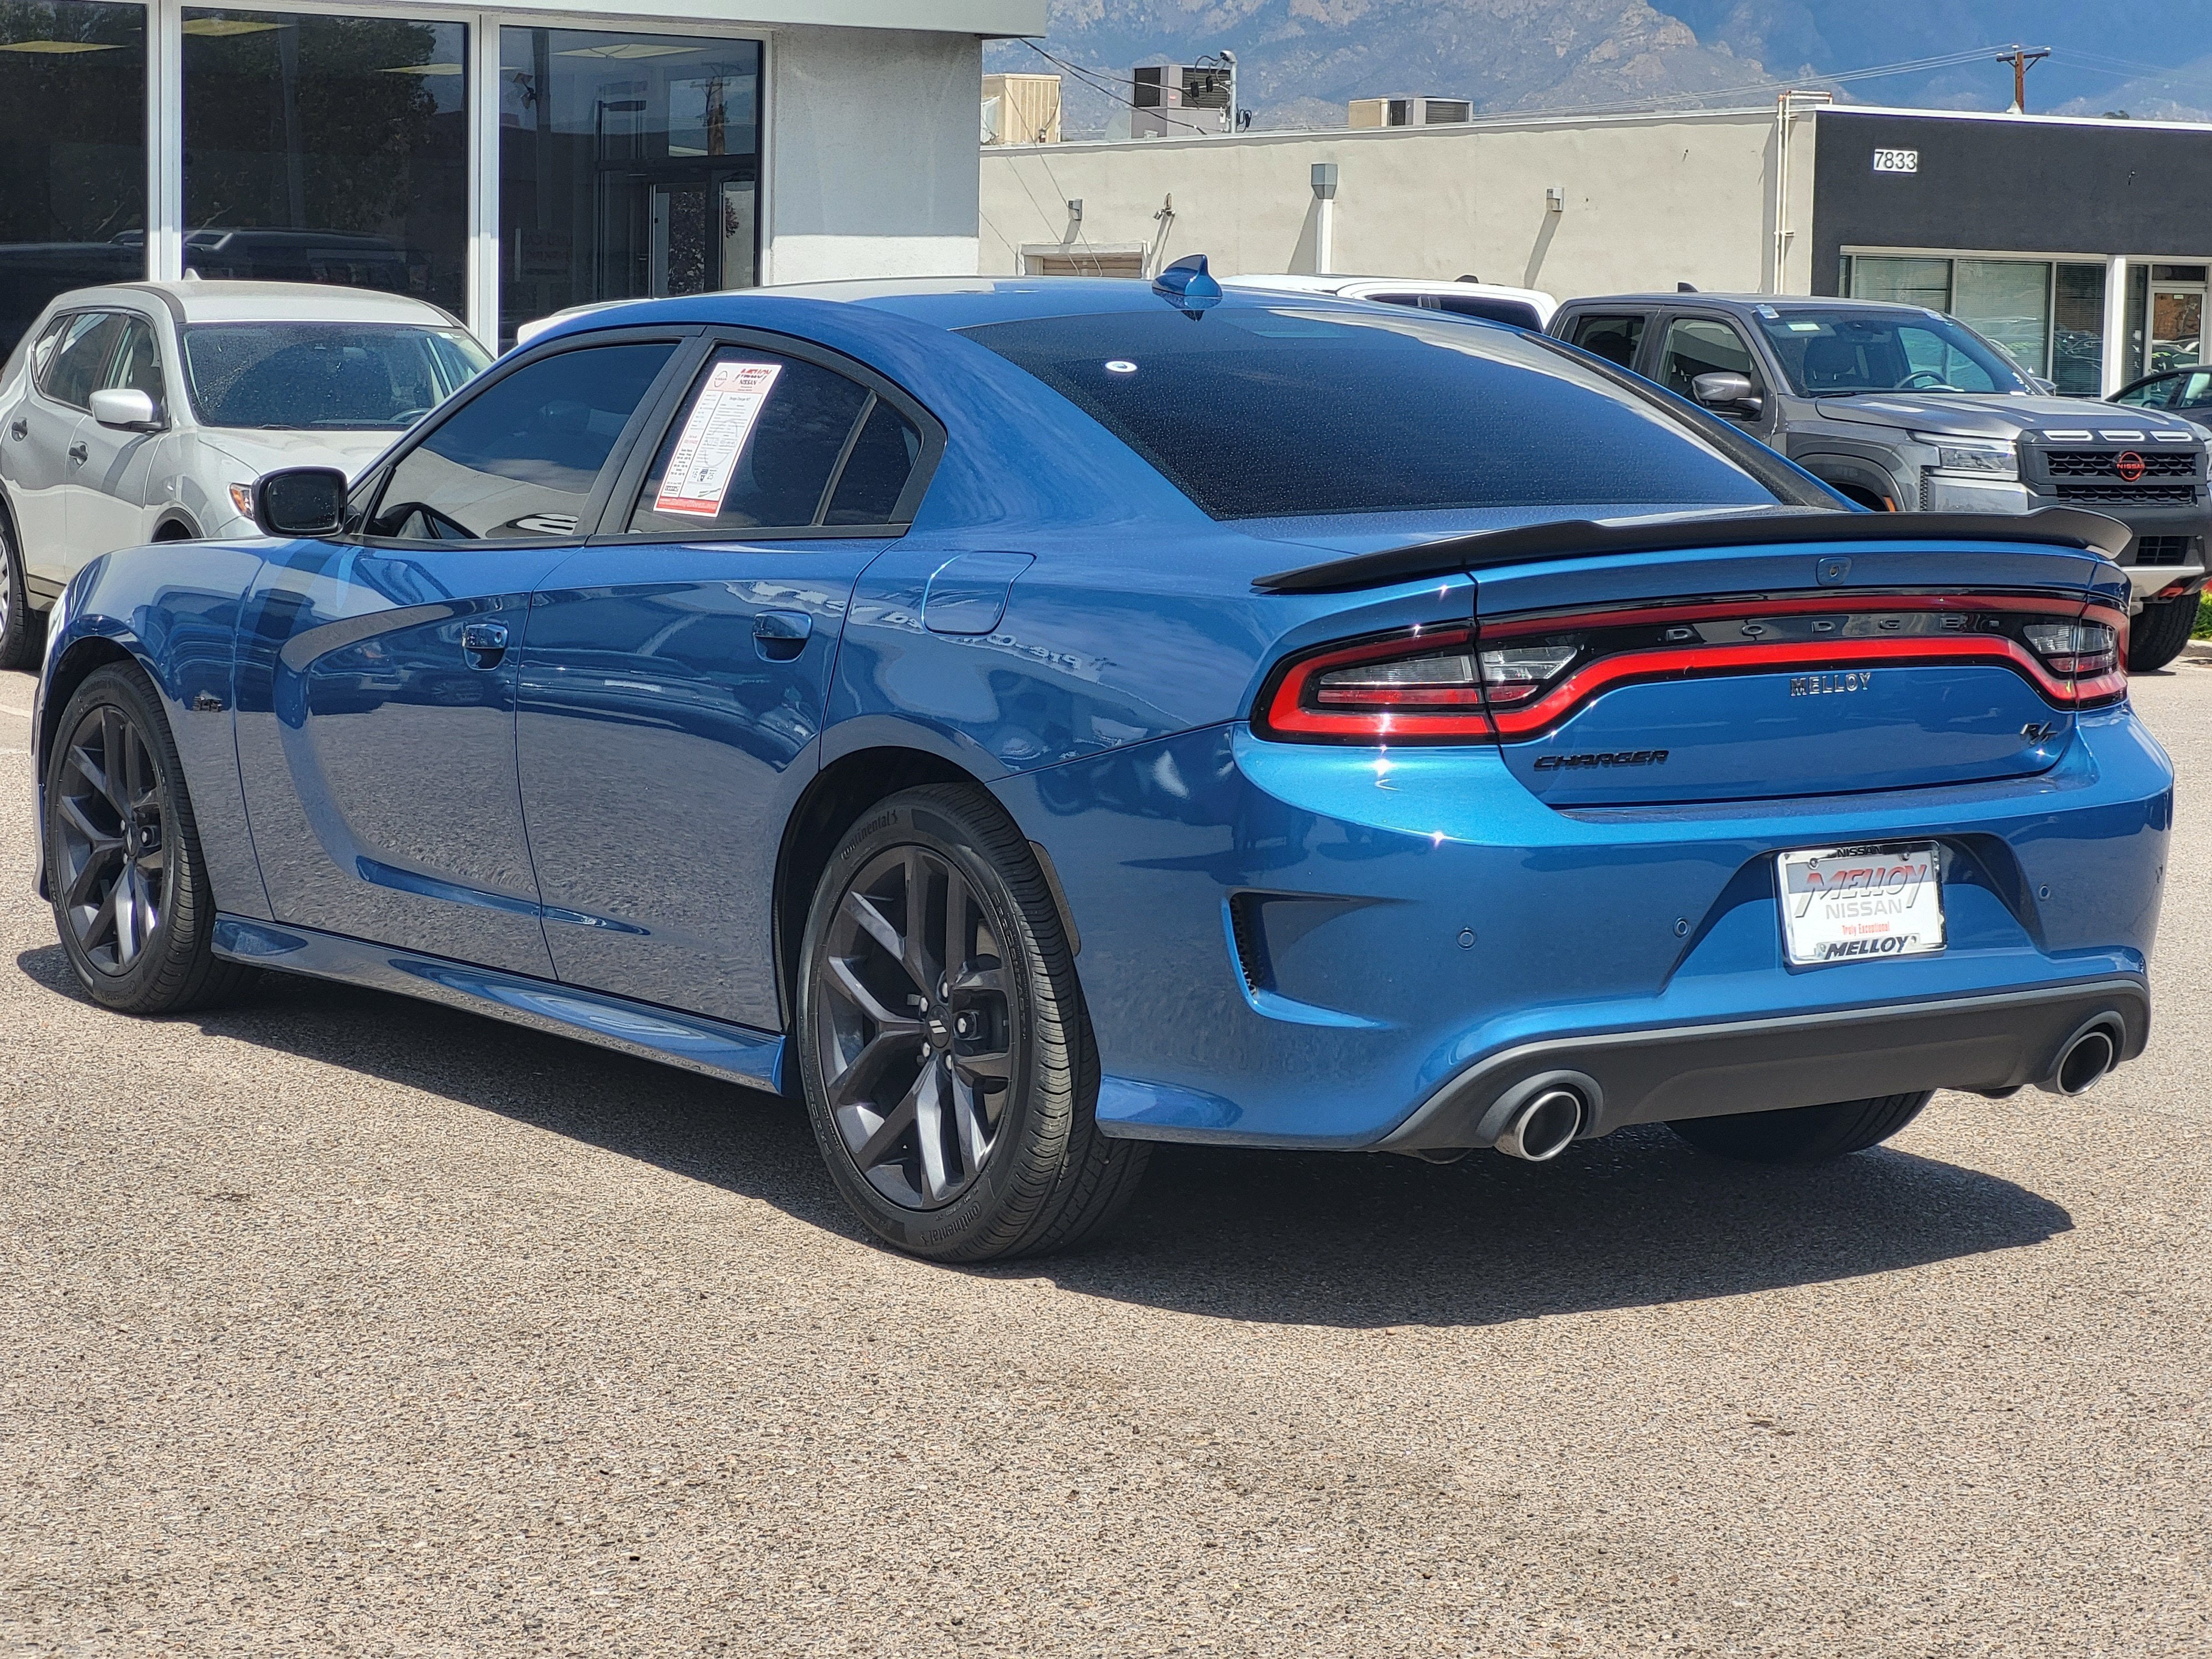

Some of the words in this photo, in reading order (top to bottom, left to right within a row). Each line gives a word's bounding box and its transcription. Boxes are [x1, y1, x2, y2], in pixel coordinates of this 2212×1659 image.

[1875, 151, 1916, 170] 7833
[1666, 614, 1966, 642] DODGE
[1790, 671, 1872, 697] MELLOY
[1533, 749, 1670, 770] CHARGER
[1836, 846, 1882, 858] NISSAN
[1794, 864, 1928, 919] MELLOY
[1825, 898, 1903, 920] NISSAN
[1841, 924, 1857, 937] Truly
[1858, 921, 1890, 934] Exceptional
[1825, 935, 1910, 960] MELLOY
